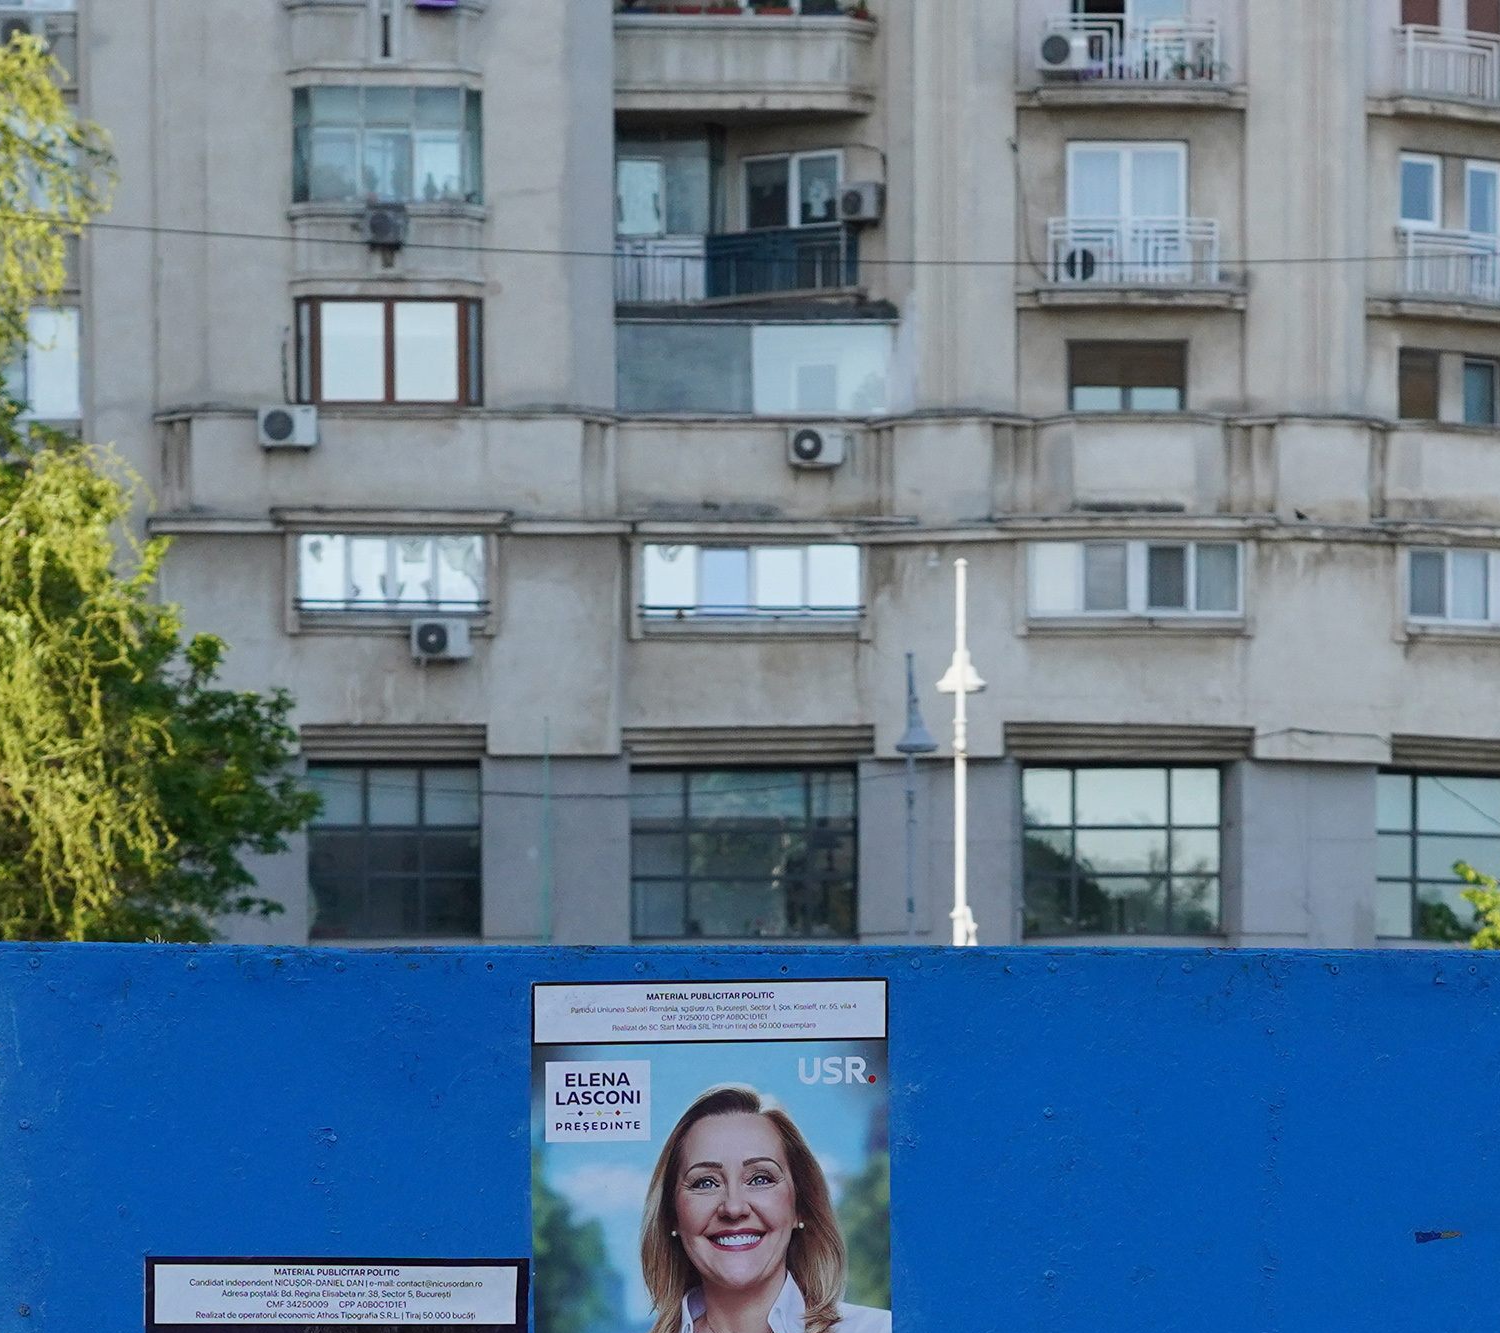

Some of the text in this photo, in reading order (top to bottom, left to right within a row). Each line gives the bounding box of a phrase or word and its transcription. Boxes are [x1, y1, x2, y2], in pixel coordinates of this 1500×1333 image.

[646, 991, 775, 1001] MATERIAL PUBLICITAR POLITIC
[565, 1072, 630, 1087] ELENA
[555, 1089, 642, 1106] LASCONI
[555, 1120, 641, 1133] PREȘEDINTE
[274, 1268, 401, 1277] MATERIAL PUBLICITAR POLITIC
[189, 1278, 224, 1286] Candidat
[225, 1279, 273, 1288] independent
[338, 1301, 355, 1309] CPP
